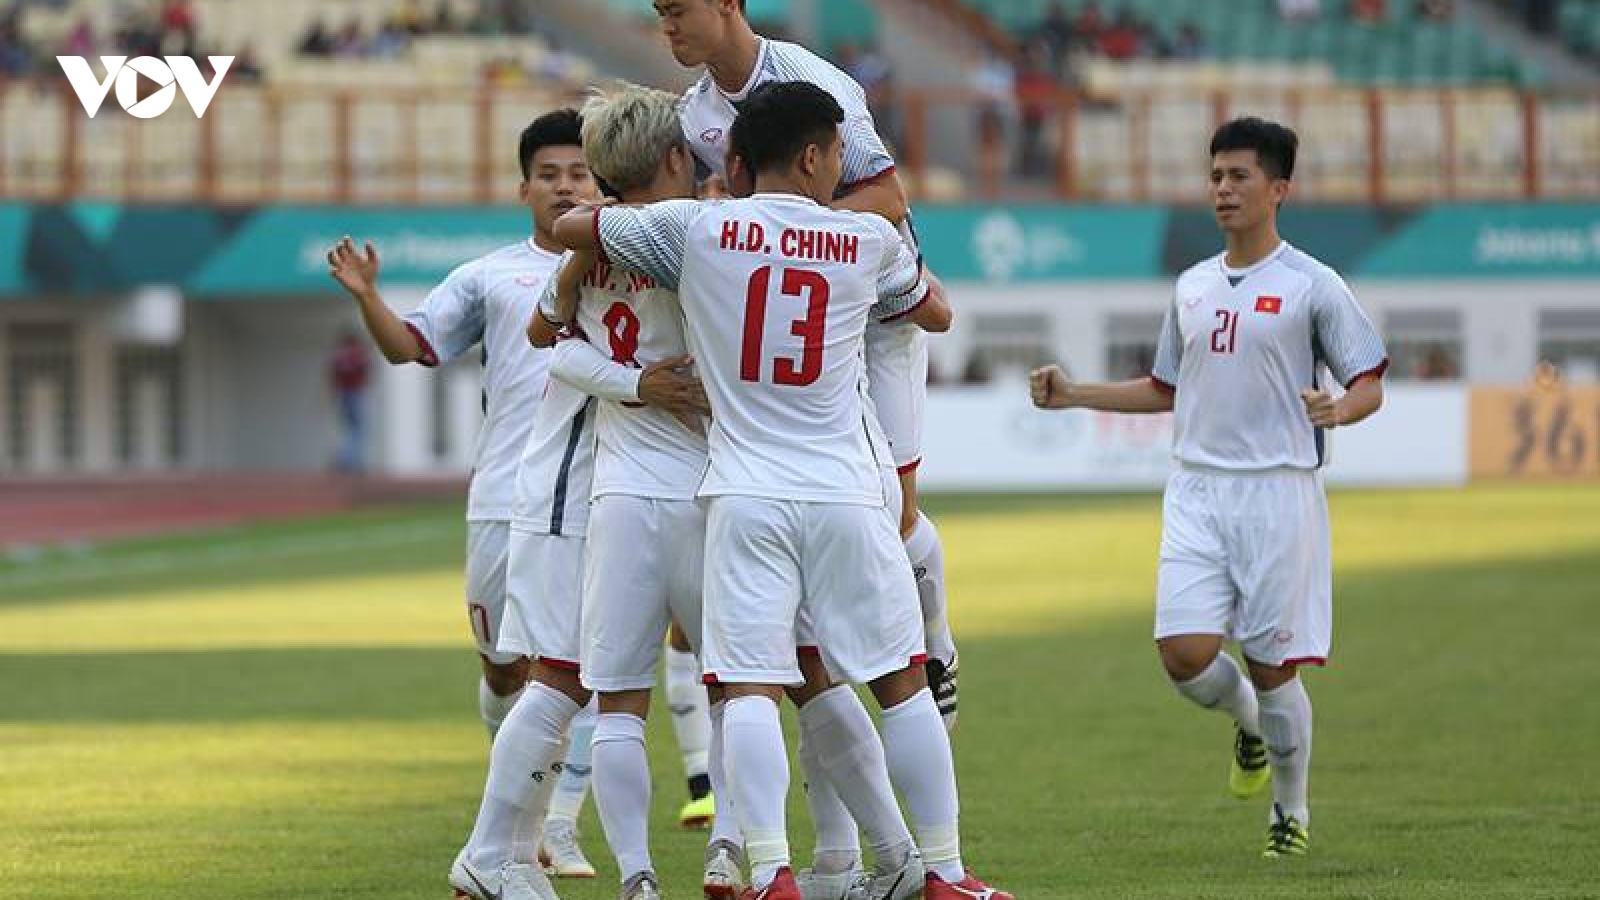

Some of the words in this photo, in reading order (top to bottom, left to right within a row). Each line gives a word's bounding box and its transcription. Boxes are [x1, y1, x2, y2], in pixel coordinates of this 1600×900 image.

[719, 220, 771, 255] H.D.
[780, 227, 859, 264] CHINH
[740, 265, 831, 387] 13
[1210, 309, 1239, 354] 21
